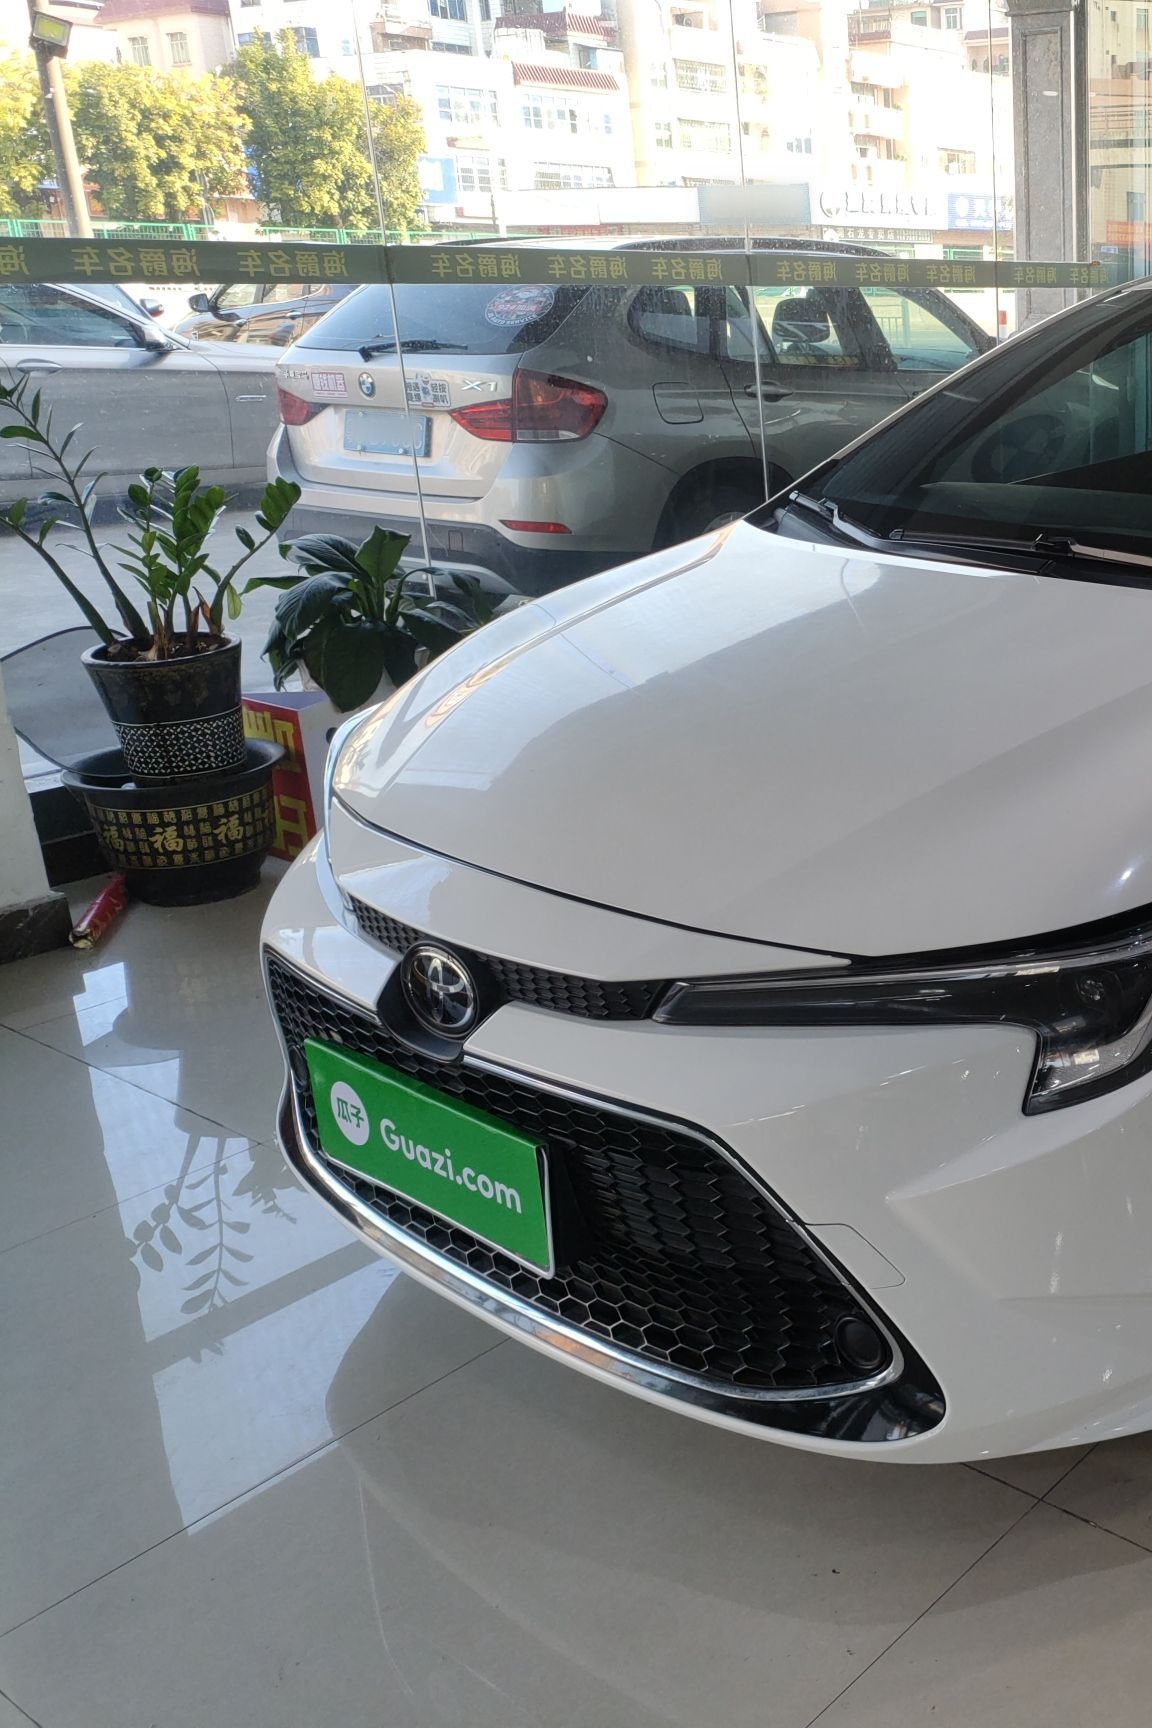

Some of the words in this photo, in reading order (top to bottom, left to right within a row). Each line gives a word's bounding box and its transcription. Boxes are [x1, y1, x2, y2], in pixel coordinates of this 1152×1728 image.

[462, 379, 498, 392] X1
[150, 825, 185, 853] 福
[213, 814, 244, 844] 福
[336, 1096, 365, 1129] 瓜子
[379, 1117, 523, 1215] Guazi.com
